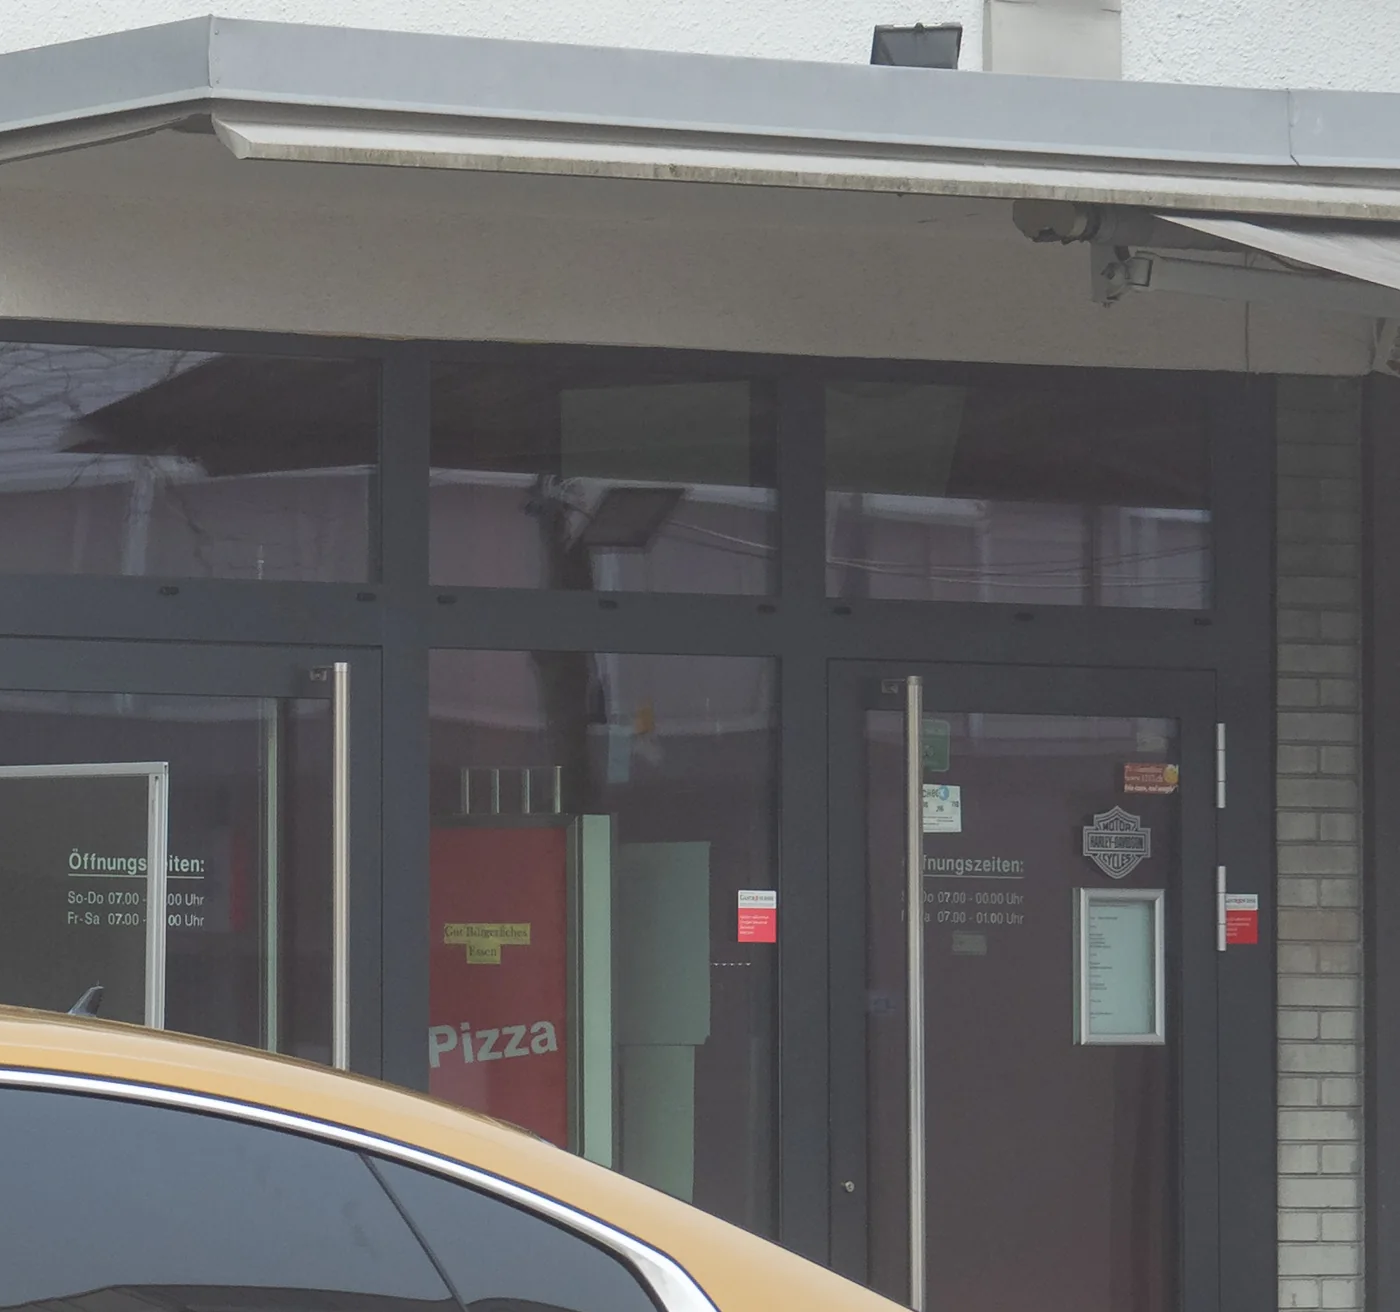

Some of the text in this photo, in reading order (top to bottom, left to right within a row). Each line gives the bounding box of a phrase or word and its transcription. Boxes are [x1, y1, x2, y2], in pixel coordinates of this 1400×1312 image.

[68, 848, 205, 875] Öffnungsiten:
[902, 854, 1024, 875] fnungszeiten:
[67, 890, 104, 904] So-Do
[108, 892, 139, 905] 07.00
[185, 893, 205, 906] Uhr
[937, 891, 966, 904] 07.00
[1006, 892, 1024, 905] Uhr
[107, 913, 139, 926] 07.00
[185, 914, 205, 927] Uhr
[937, 911, 966, 923] 07.00
[976, 912, 1003, 924] 01.00
[1006, 912, 1024, 925] Uhr
[469, 946, 497, 957] Essen
[428, 1019, 559, 1069] Pizza
